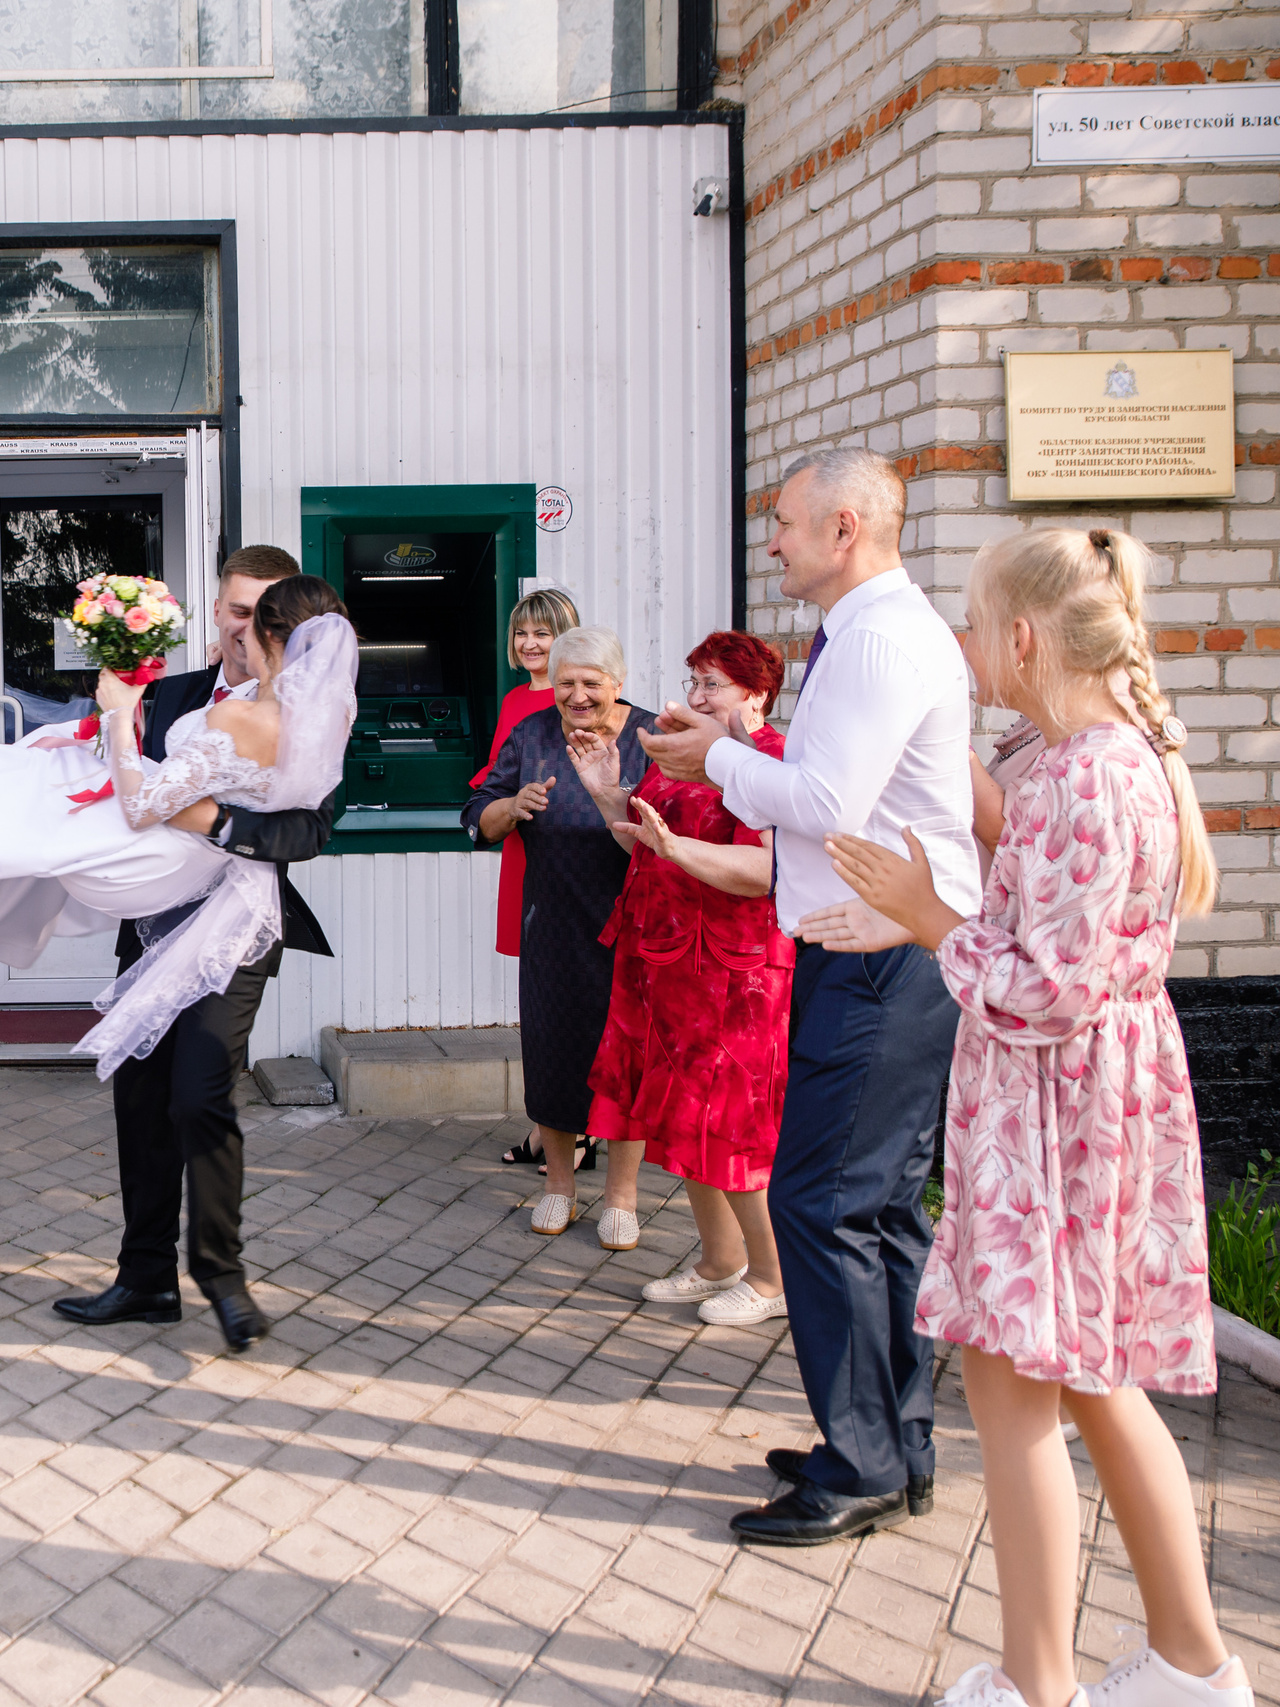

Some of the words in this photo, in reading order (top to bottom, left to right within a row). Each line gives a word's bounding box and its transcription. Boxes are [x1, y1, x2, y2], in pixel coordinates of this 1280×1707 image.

[1047, 121, 1073, 136] ул.
[1078, 117, 1098, 132] 50
[1104, 119, 1134, 131] лет
[1139, 113, 1235, 131] Советской
[1078, 406, 1106, 414] ТРУДУ
[1117, 405, 1170, 413] ЗАНЯТОСТИ
[1171, 404, 1226, 412] НАСЕЛЕНИЯ
[1084, 414, 1127, 422] КУРСКОЙ
[1144, 437, 1206, 445] УЧРЕЖДЕНИЕ
[1038, 448, 1077, 457] «ЦЕНТР
[1079, 447, 1140, 455] ЗАНЯТОСТИ
[1142, 446, 1206, 455] НАСЕЛЕНИЯ
[1055, 458, 1143, 466] КОНЫШЕВСКОГО
[1051, 469, 1077, 478] «ЦЗН
[1078, 468, 1167, 477] КОНЫШЕВСКОГО
[1169, 466, 1217, 476] РАЙОНА»
[541, 498, 565, 507] TOTAL
